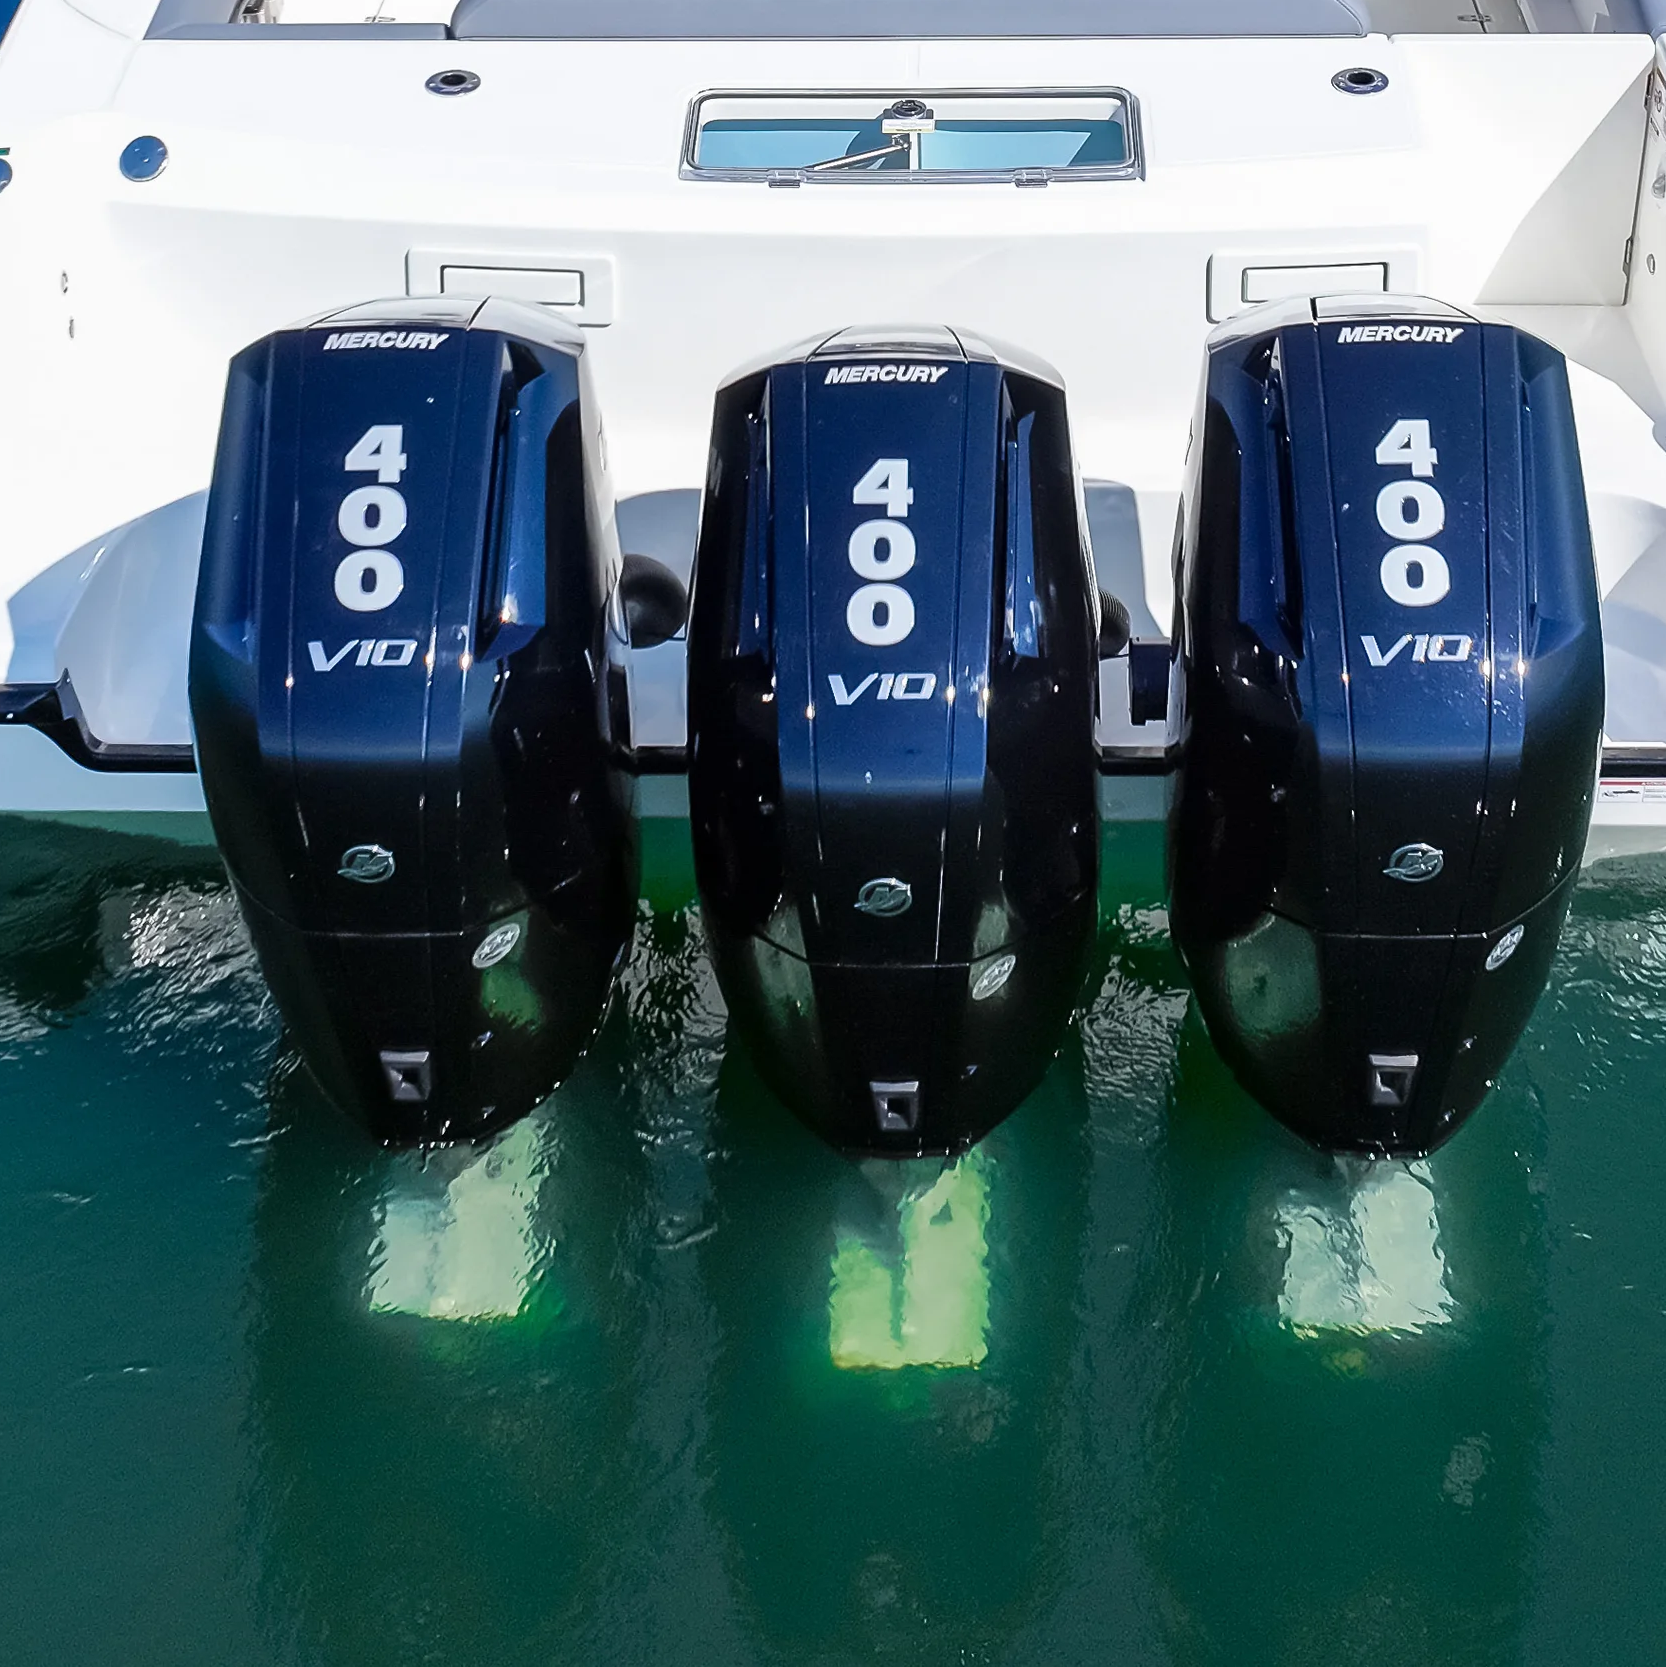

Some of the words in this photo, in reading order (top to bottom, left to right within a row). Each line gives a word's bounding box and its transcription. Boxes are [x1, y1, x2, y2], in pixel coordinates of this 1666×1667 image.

[323, 331, 449, 350] MERCURY
[1337, 325, 1464, 344] MERCURY
[824, 364, 949, 385] MERCURY
[334, 424, 407, 612] 400
[1374, 418, 1451, 608] 400
[846, 458, 917, 647] 400
[308, 638, 418, 672] V10
[1361, 633, 1473, 667] V10
[827, 672, 936, 706] V10
